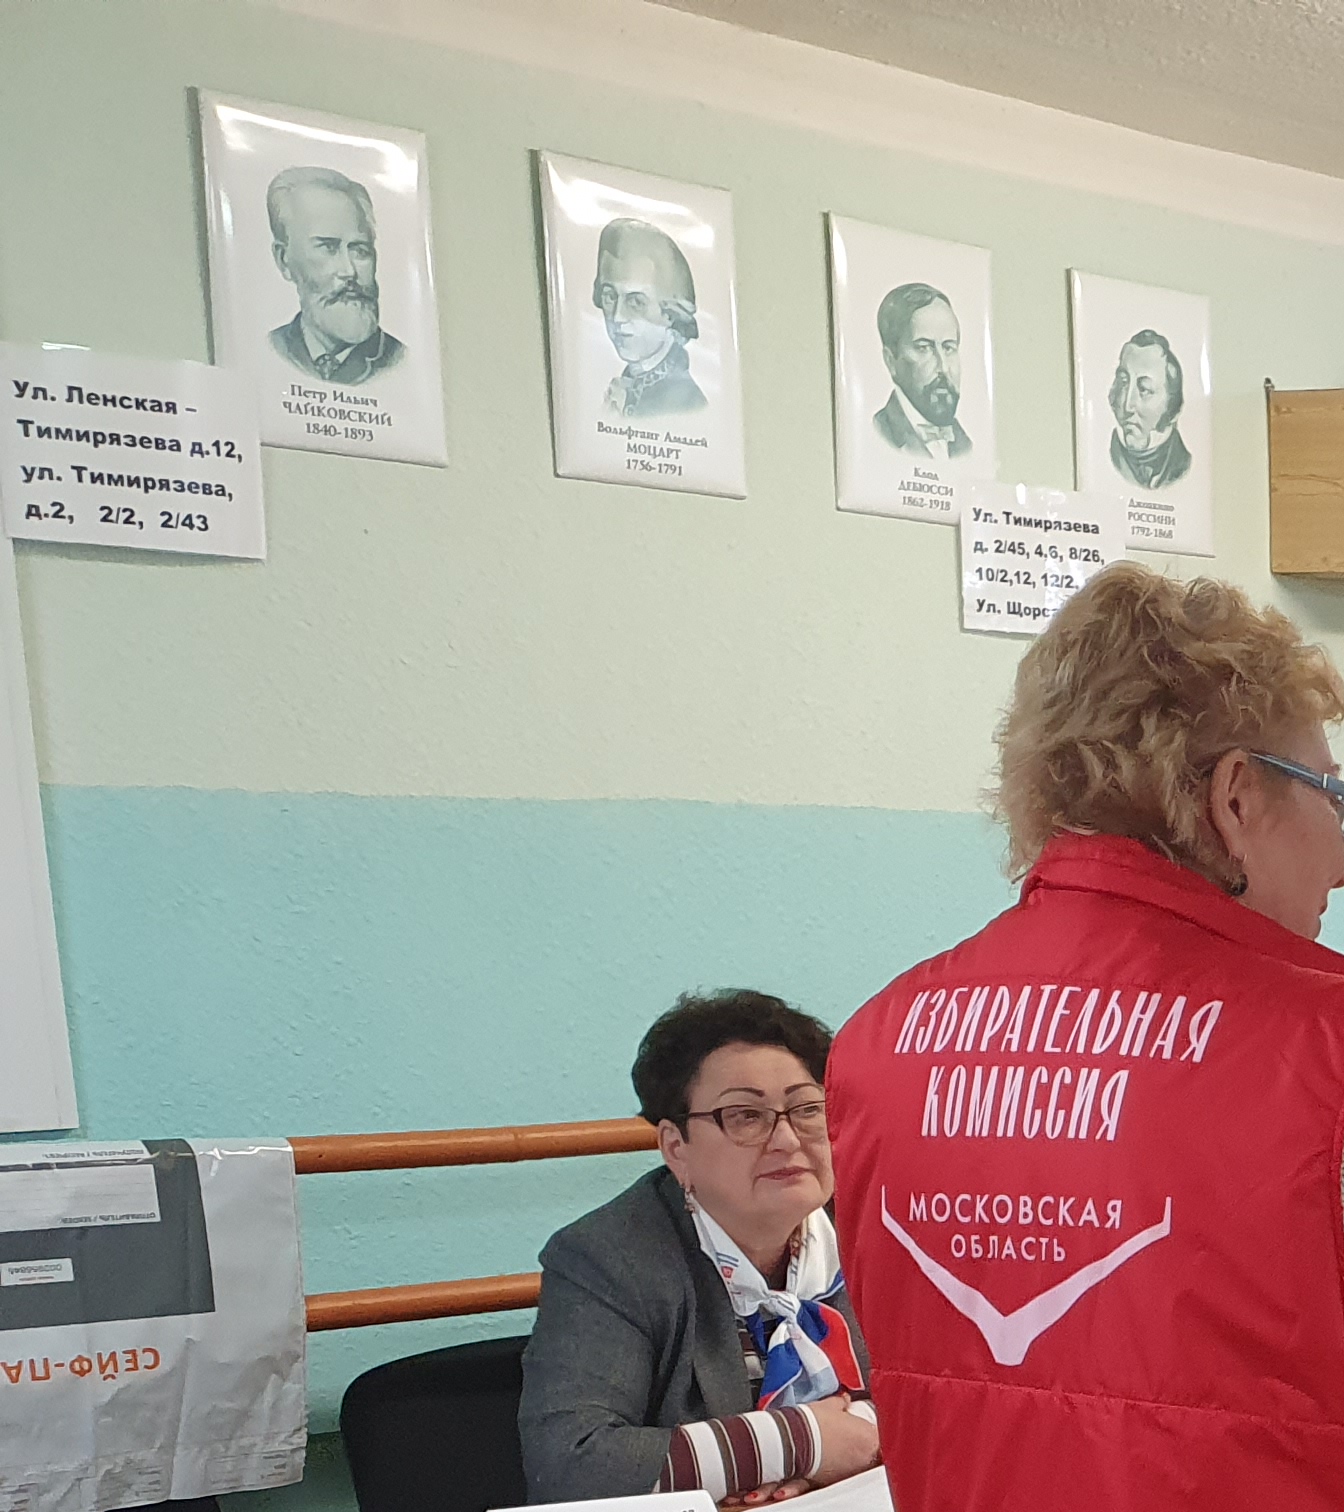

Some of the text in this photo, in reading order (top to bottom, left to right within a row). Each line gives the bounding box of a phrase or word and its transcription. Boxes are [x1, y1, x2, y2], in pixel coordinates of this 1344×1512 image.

[12, 379, 57, 402] Ул.
[65, 385, 178, 415] Ленская
[290, 384, 378, 408] Петр Ильич
[282, 400, 393, 427] ЧАЙКОВСКИЙ
[16, 418, 243, 463] Тимирязева д.12,
[305, 422, 374, 442] 1840-1893
[626, 442, 682, 459] МОЦАРТ
[626, 459, 683, 476] 1756-1791
[20, 464, 233, 502] ул. Тимирязева,
[898, 480, 954, 497] ДЕБЮССИ
[25, 501, 209, 532] д.2, 2/2, 2/43
[902, 496, 951, 511] 1862-1918
[972, 507, 1100, 534] Ул. Тимирязева
[1128, 511, 1176, 526] РОССИНИ
[973, 541, 989, 554] д.
[993, 539, 1030, 559] 2/45,
[1068, 547, 1105, 565] 8/26,
[976, 598, 1058, 620] Ул. Щорс
[894, 983, 1224, 1063] ИЗБИРАТЕЛЬНАЯ
[921, 1065, 1130, 1141] КОМИССИЯ
[909, 1191, 1123, 1230] МОСКОВСКАЯ
[950, 1233, 1067, 1262] ОБЛАСТЬ
